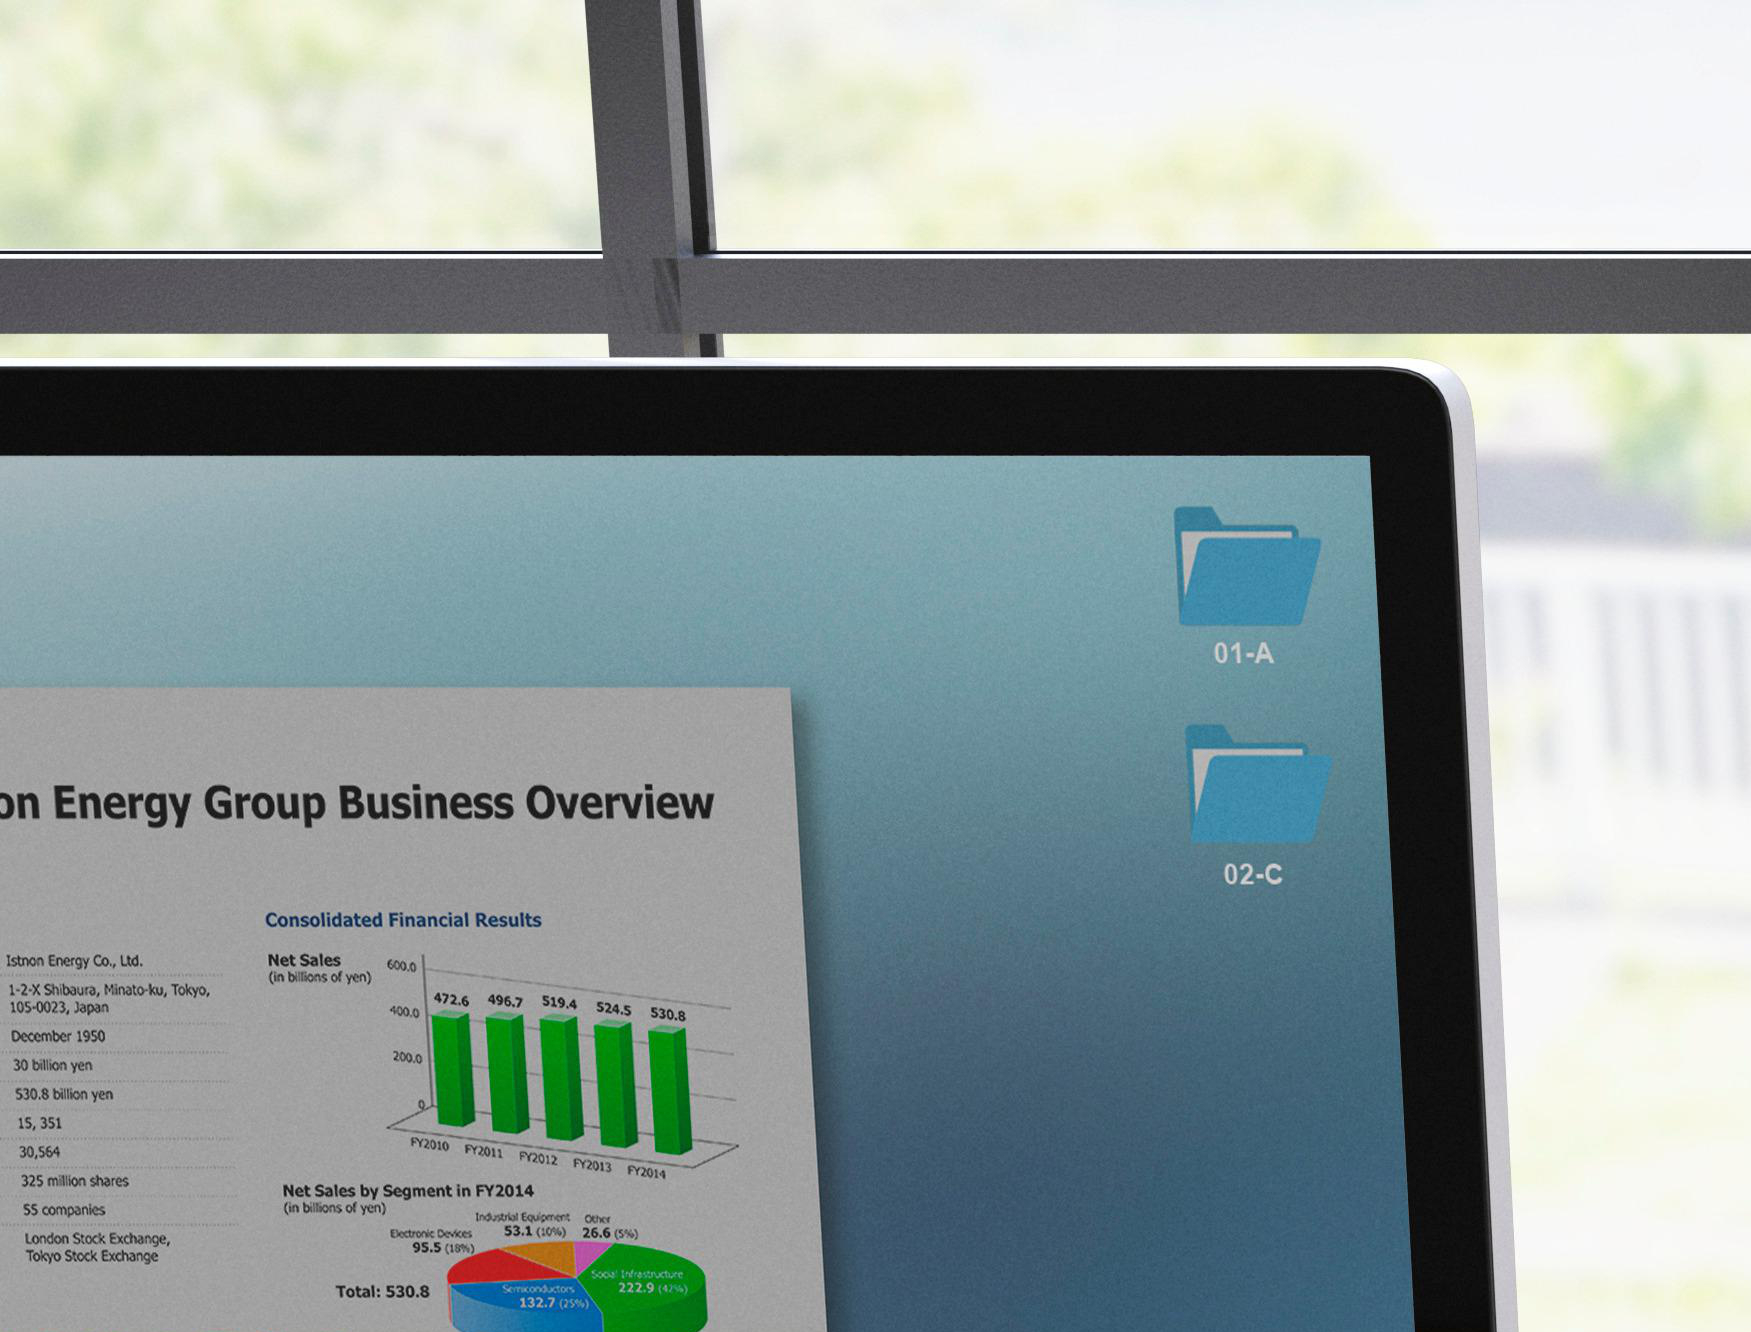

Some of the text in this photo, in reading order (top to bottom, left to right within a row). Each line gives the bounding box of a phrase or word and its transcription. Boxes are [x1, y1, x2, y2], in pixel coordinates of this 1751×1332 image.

[1214, 642, 1274, 664] 01-A
[53, 785, 191, 828] Energy
[204, 785, 326, 828] Group
[339, 783, 514, 820] Business
[526, 783, 715, 820] Overview
[1224, 863, 1283, 885] 02-C
[265, 912, 542, 928] Consolidated Financial Results
[6, 954, 143, 971] Istnon Energy Co., Ltd.
[266, 953, 341, 967] Net Sales
[268, 970, 372, 986] (in billions of yen)
[9, 983, 210, 999] 1-2-X Shibaura, Minato-ku, Tokyo,
[10, 1000, 110, 1016] 105-0023, Japan
[11, 1029, 106, 1043] December 1950
[13, 1058, 93, 1074] 30 billion yen
[15, 1087, 114, 1104] 530.8 billion yen
[18, 1116, 62, 1132] 15, 351
[19, 1145, 61, 1160] 30,564
[21, 1174, 130, 1188] 325 million shares
[283, 1184, 535, 1203] Net Sales by Segment in FY2014
[23, 1203, 106, 1218] 55 companies
[25, 1232, 171, 1248] London Stock Exchange,
[25, 1249, 159, 1265] Tokyo Stock Exchange
[335, 1284, 430, 1299] Total: 530.8
